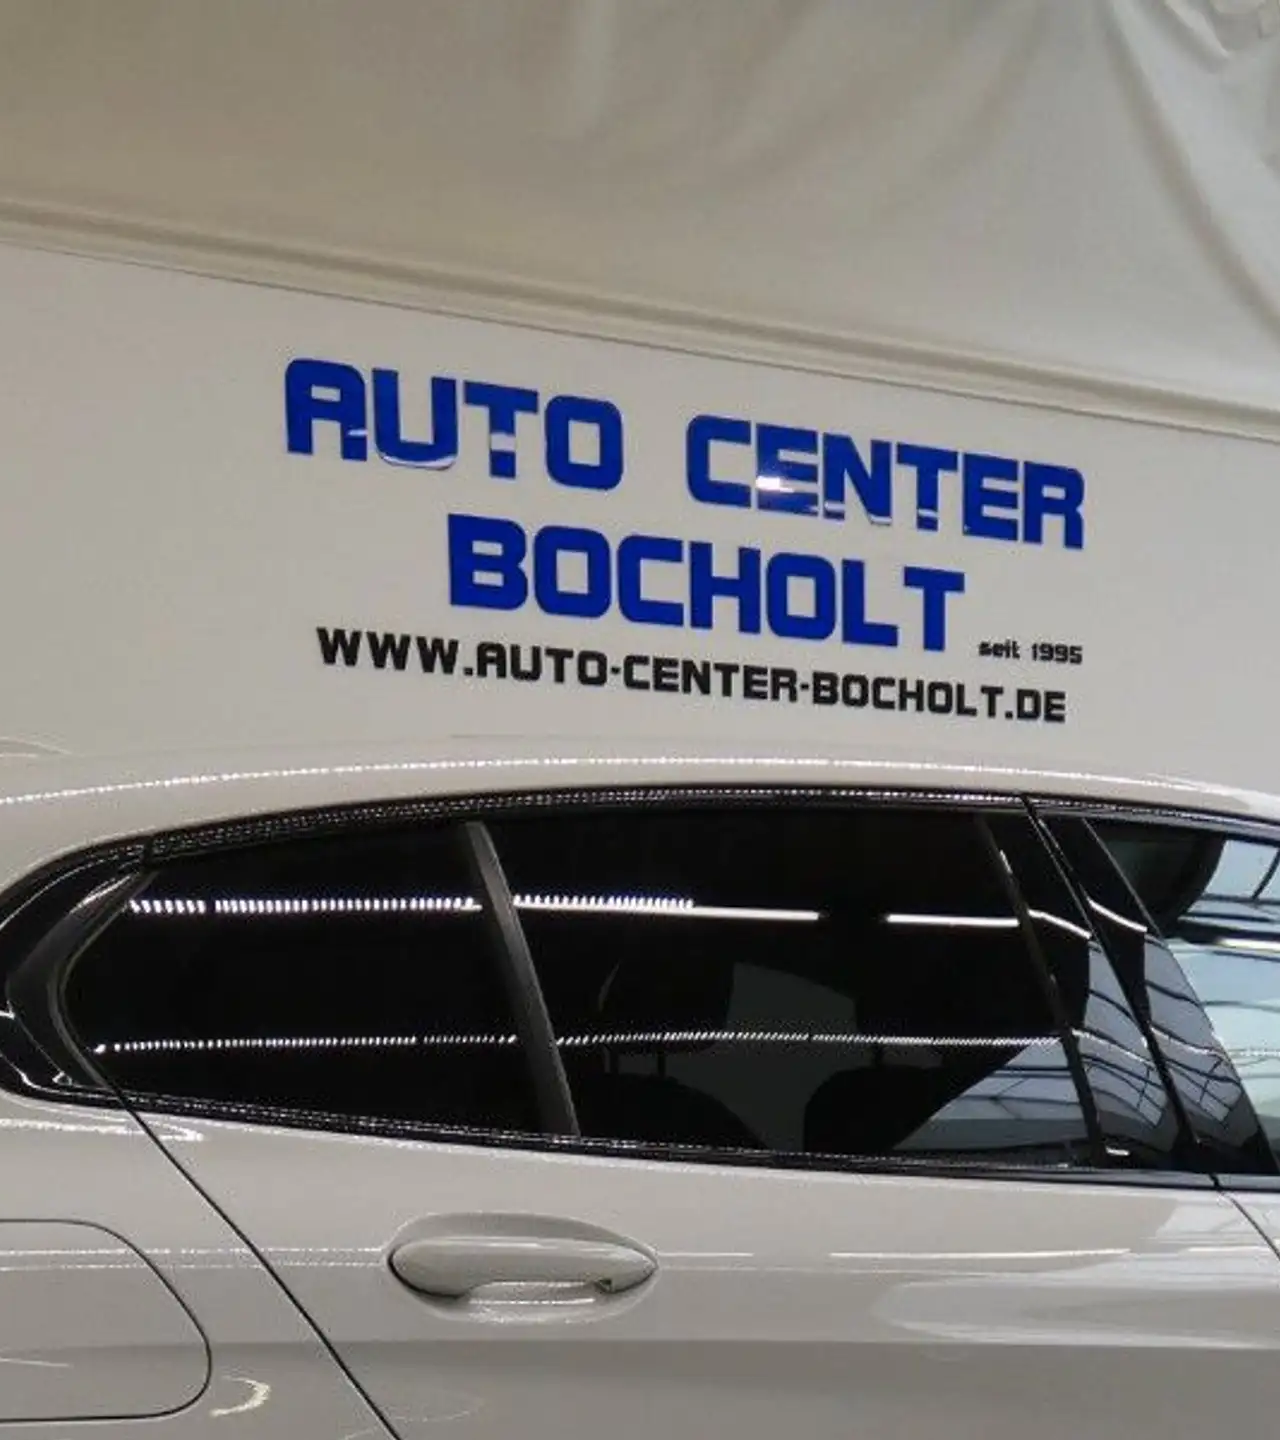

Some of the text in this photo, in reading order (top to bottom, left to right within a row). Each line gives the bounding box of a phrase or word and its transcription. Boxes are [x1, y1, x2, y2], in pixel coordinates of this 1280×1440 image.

[285, 357, 1085, 550] AUTO CENTER
[446, 513, 965, 653] BOCHOLT
[316, 625, 1067, 724] WWW.AUTO-CENTER-BOCHOLT.DE
[977, 639, 1083, 665] seit 1995
